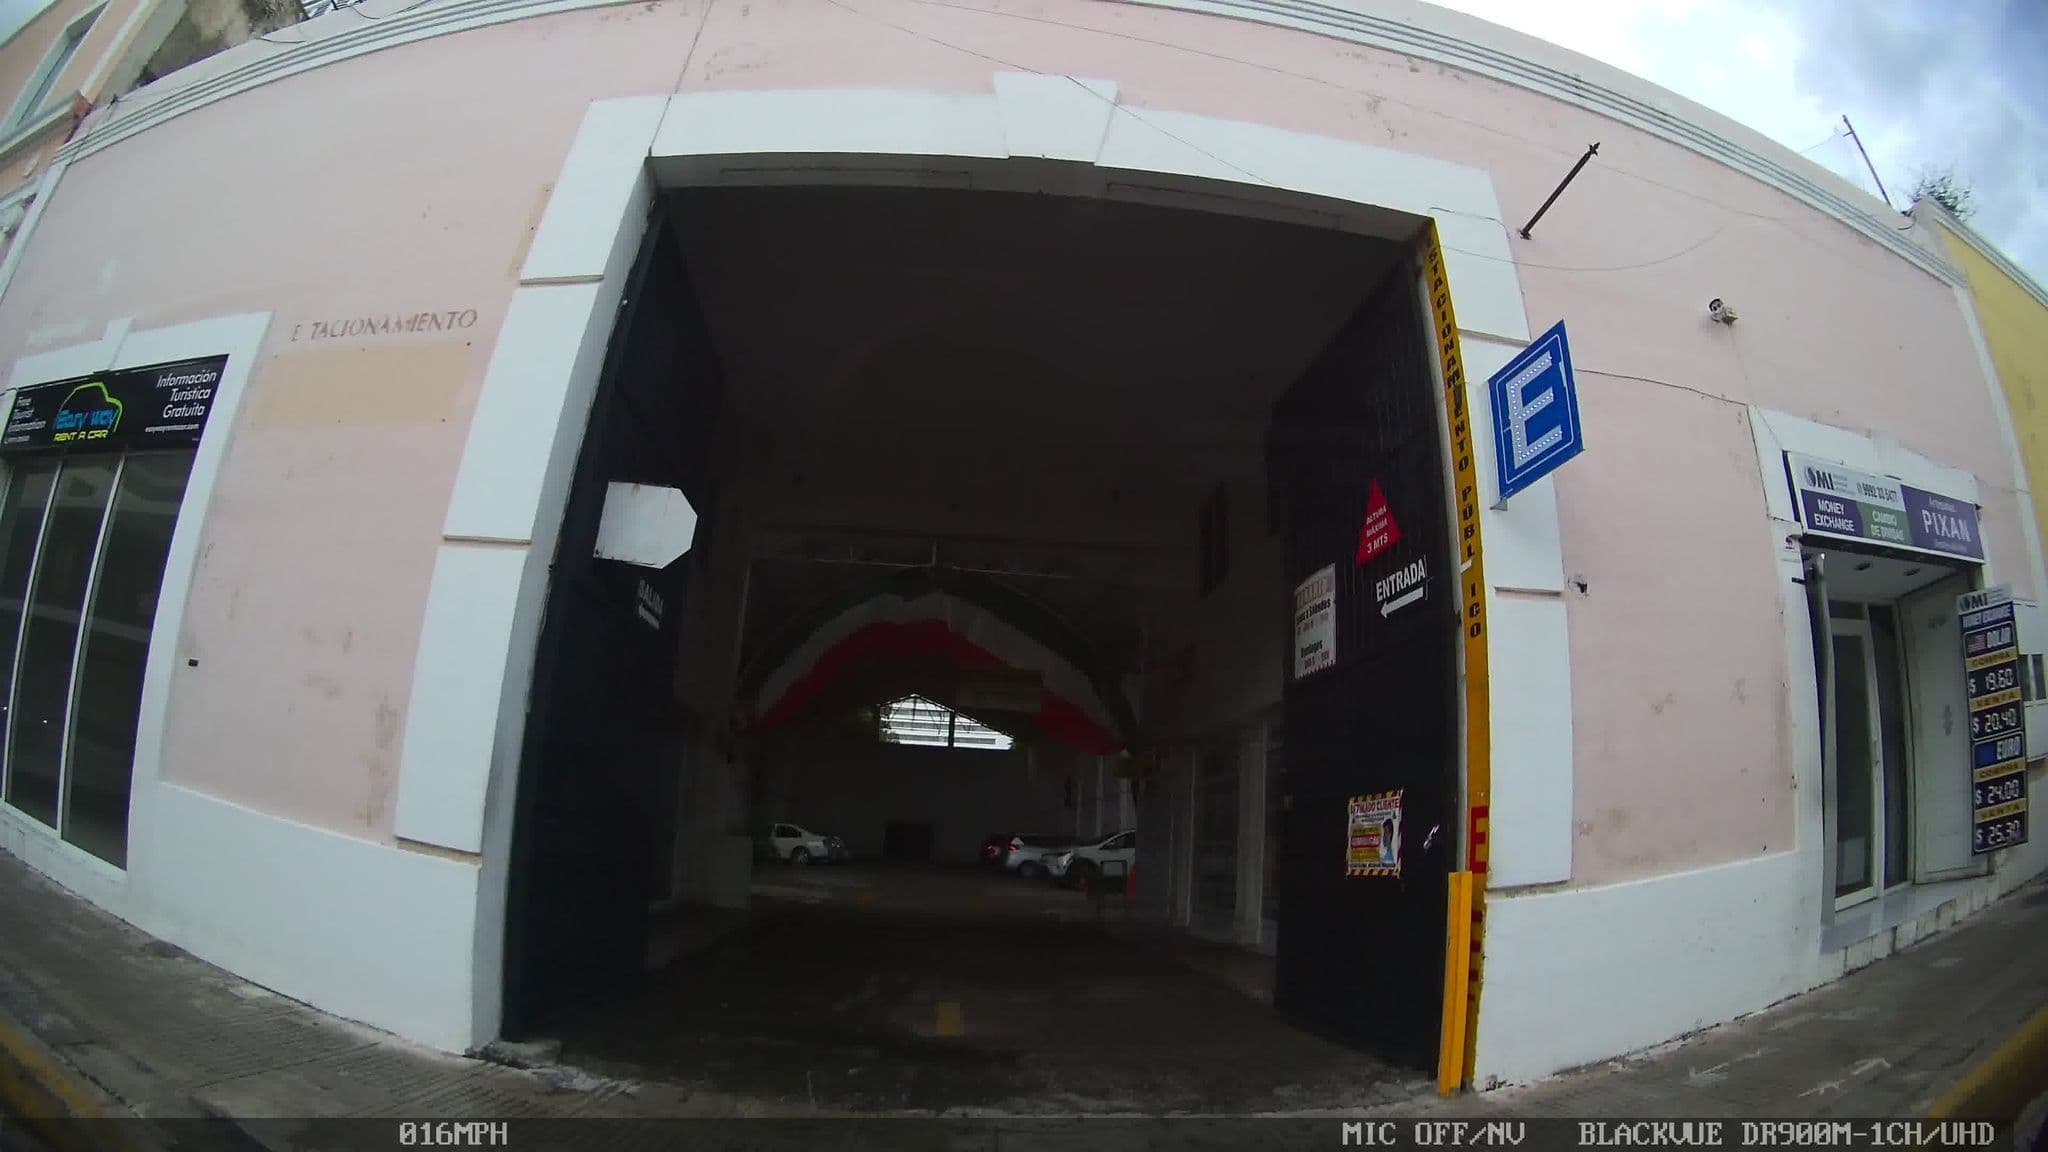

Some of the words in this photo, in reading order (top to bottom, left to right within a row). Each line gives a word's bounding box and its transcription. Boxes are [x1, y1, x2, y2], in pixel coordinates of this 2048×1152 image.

[291, 308, 478, 342] ETACIONAMIENTO
[1428, 238, 1469, 472] STACIONAMENTO
[157, 370, 217, 388] Información
[163, 402, 206, 418] Gratuita
[1506, 350, 1562, 470] E
[53, 433, 77, 442] RENT
[78, 431, 85, 440] A
[87, 429, 108, 439] CAR
[1366, 505, 1387, 525] ALTURA
[1817, 499, 1845, 515] MONEY
[1814, 513, 1855, 531] EXCHANGE
[1921, 509, 1972, 542] PIXAN
[1367, 542, 1373, 554] 3
[1373, 532, 1389, 551] MTS
[1376, 558, 1426, 602] ENTRADA
[1985, 708, 2017, 732] 20.40
[1988, 780, 2019, 804] 24.00
[1469, 806, 1488, 873] E
